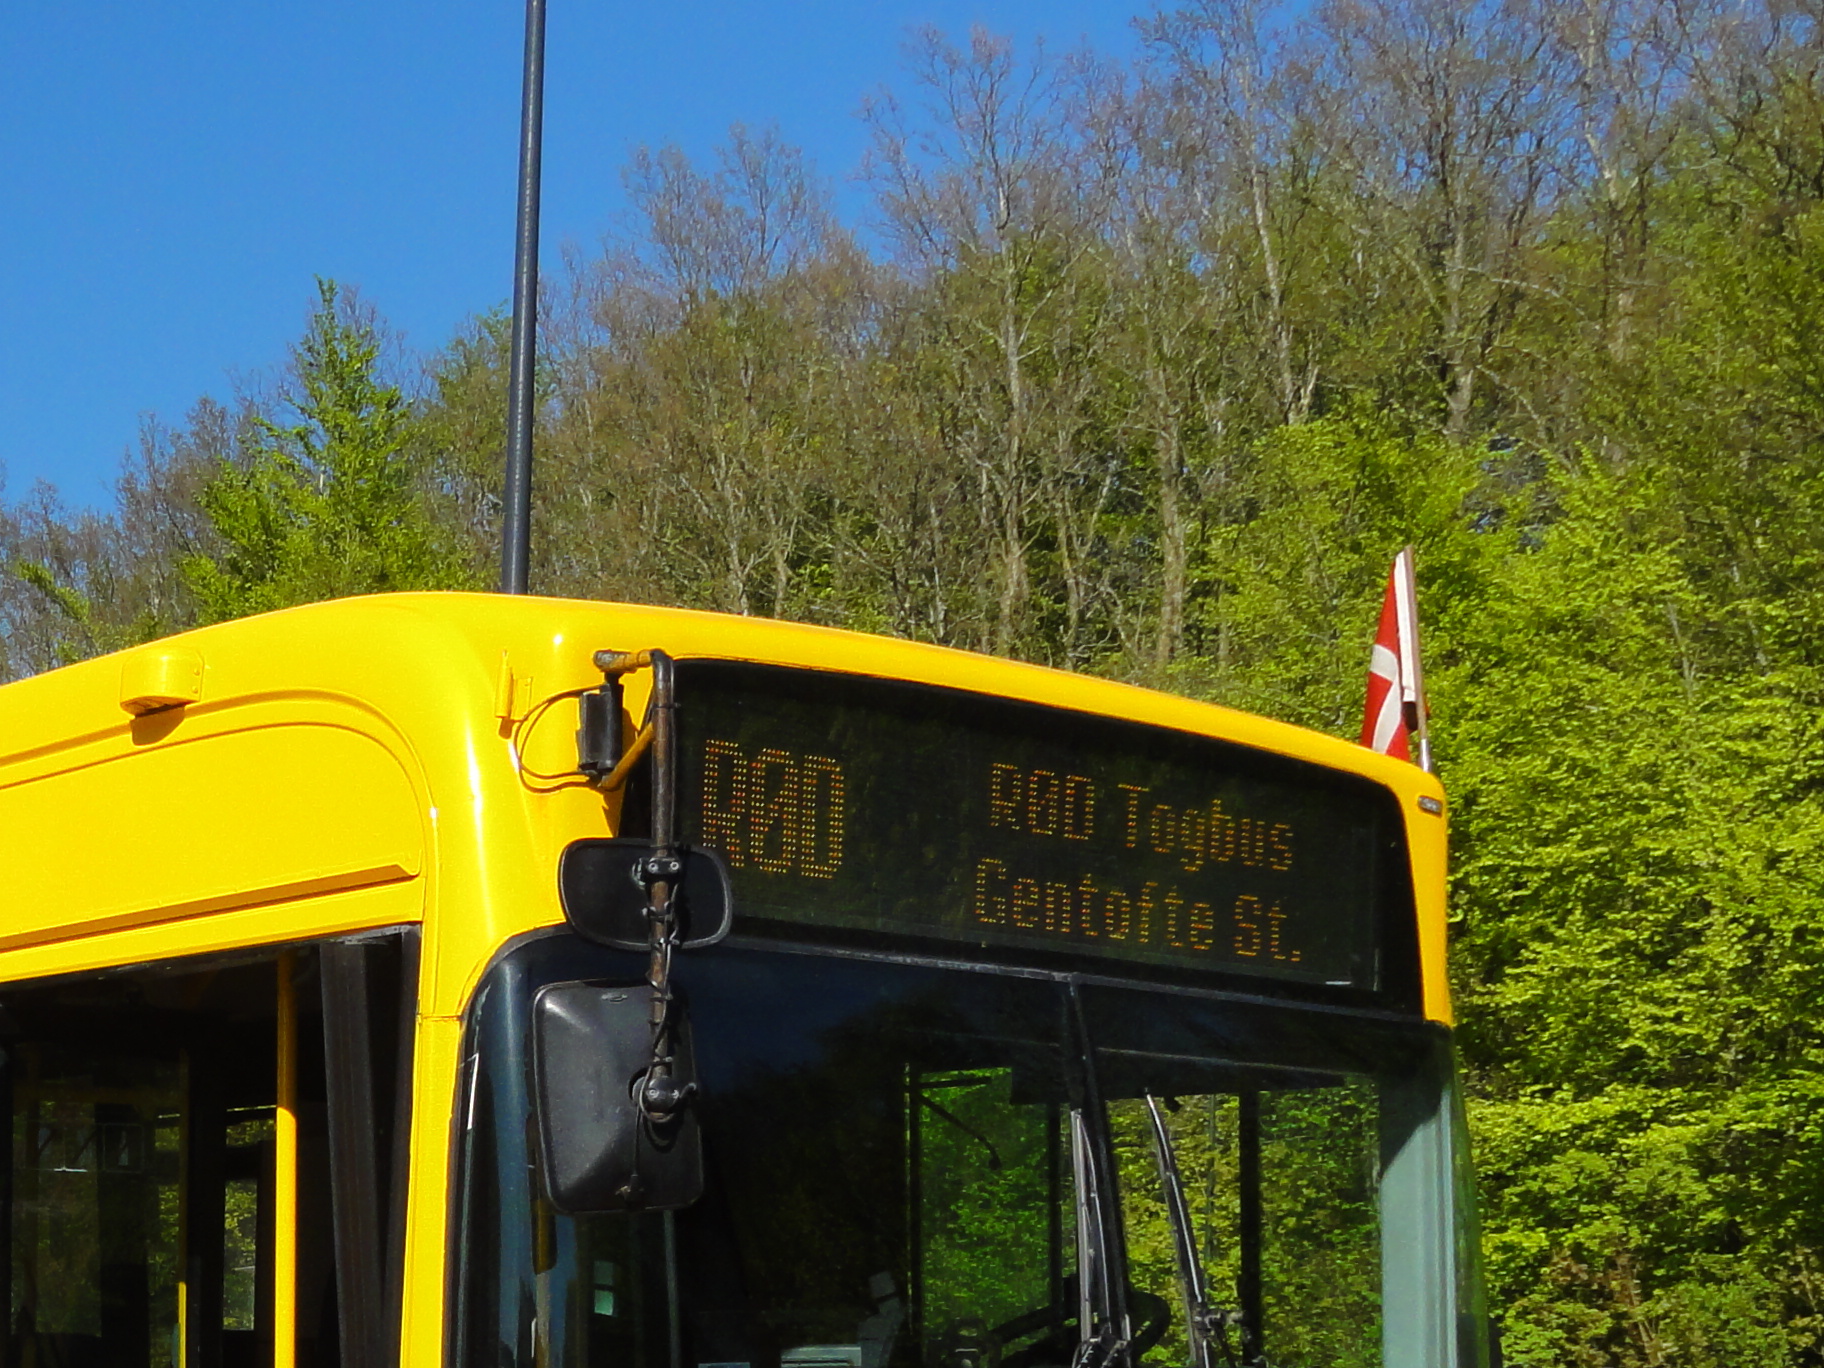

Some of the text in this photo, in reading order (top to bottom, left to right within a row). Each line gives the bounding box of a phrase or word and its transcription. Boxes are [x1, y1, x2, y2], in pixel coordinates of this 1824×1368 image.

[1117, 783, 1294, 872] Togbus
[974, 857, 1301, 962] Gentofte St.
